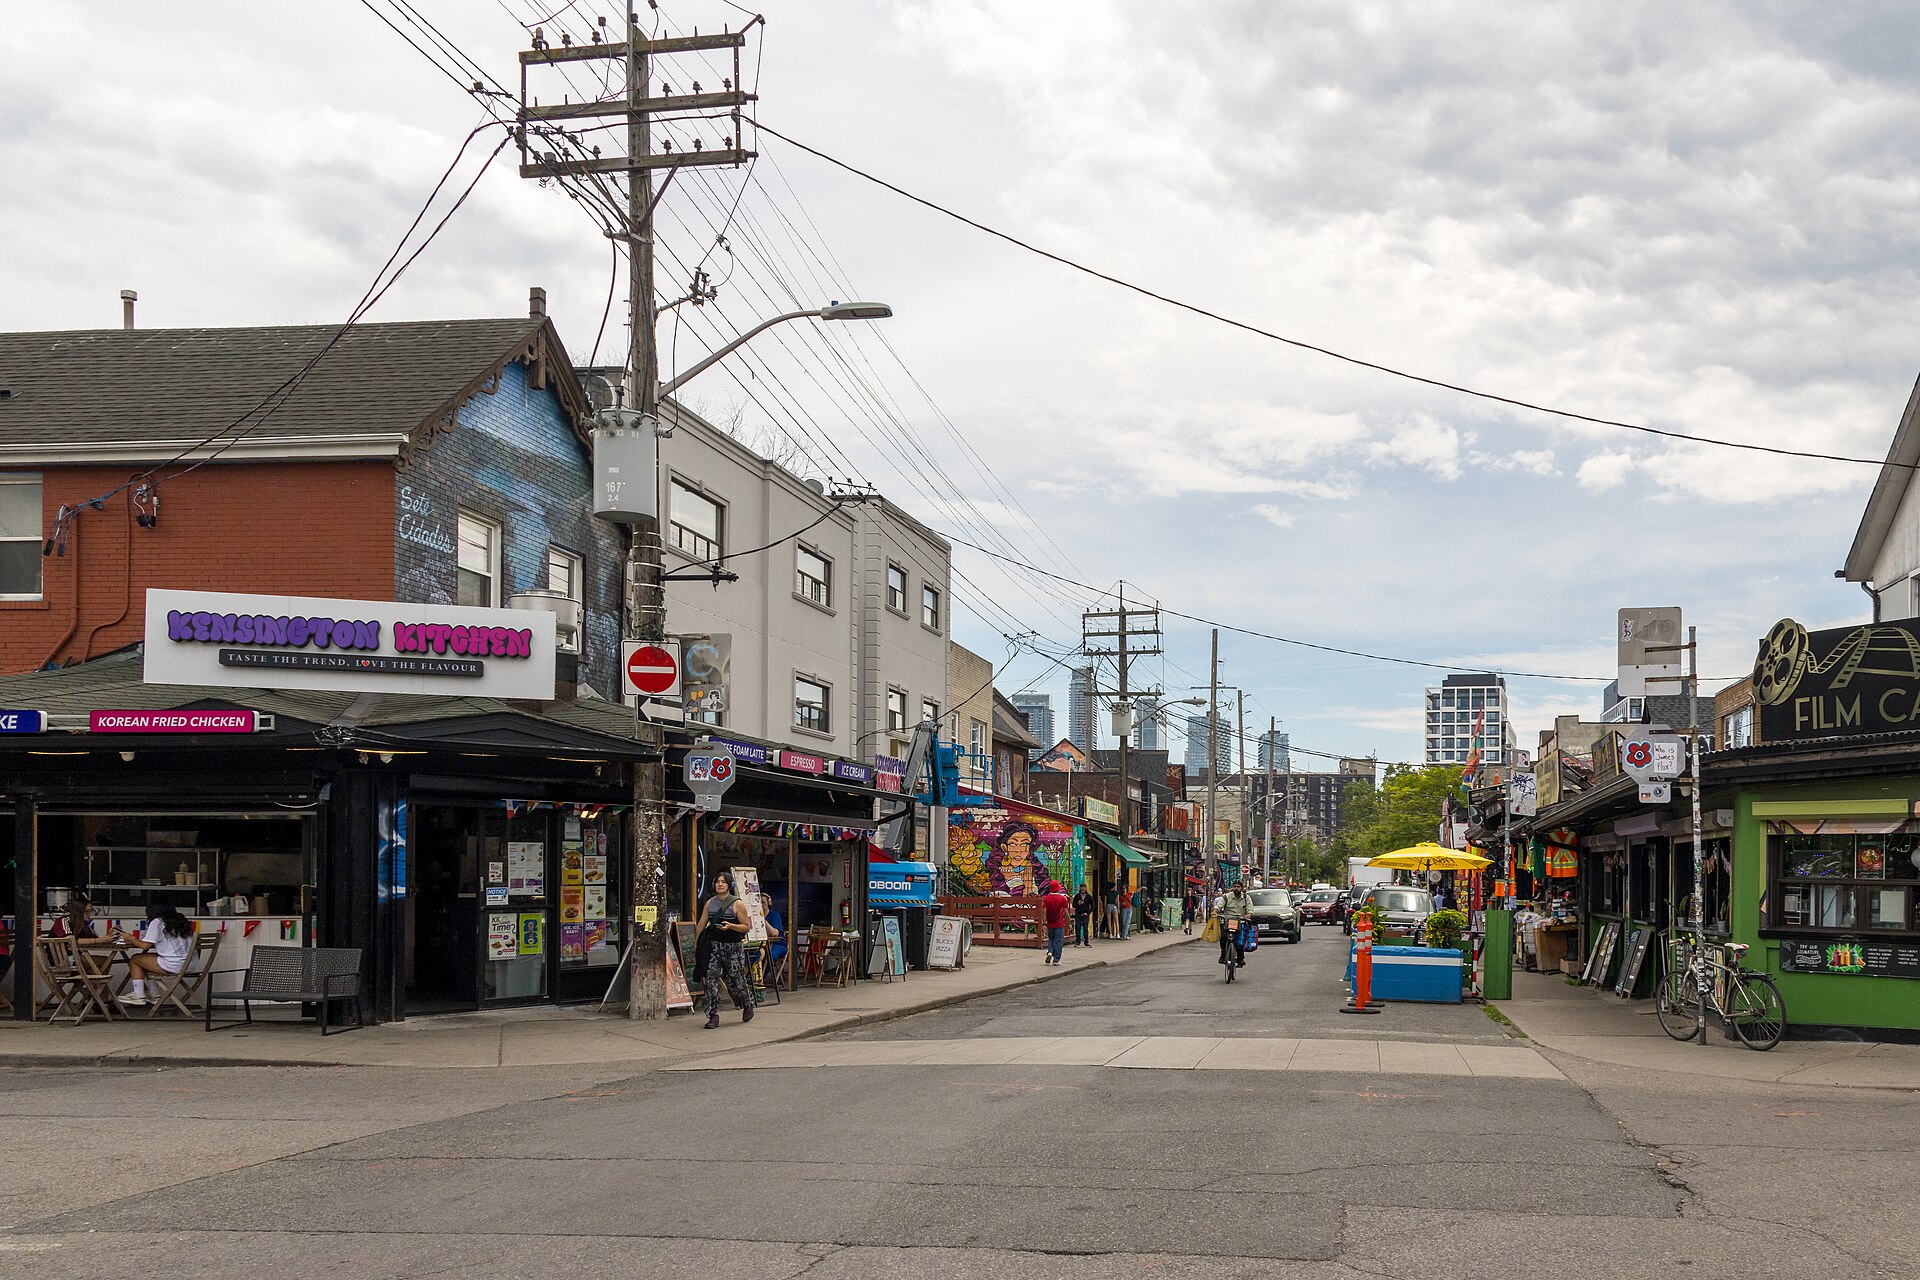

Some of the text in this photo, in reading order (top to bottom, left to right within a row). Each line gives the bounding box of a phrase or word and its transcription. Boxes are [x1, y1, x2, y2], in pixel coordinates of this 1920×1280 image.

[167, 609, 532, 658] KENSINGTON KITCHEN
[228, 653, 267, 663] TASTE
[273, 655, 298, 664] THE
[303, 657, 350, 667] TREND,
[392, 661, 416, 670] THE
[421, 662, 477, 672] FLAVOUR
[1795, 692, 1861, 731] FILM
[98, 716, 245, 727] KOREAN FRIED CHICKEN
[733, 745, 750, 757] FOAM
[750, 747, 764, 760] LATTE
[790, 755, 815, 770] ESPRESSO
[841, 764, 865, 779] ICE CREAM
